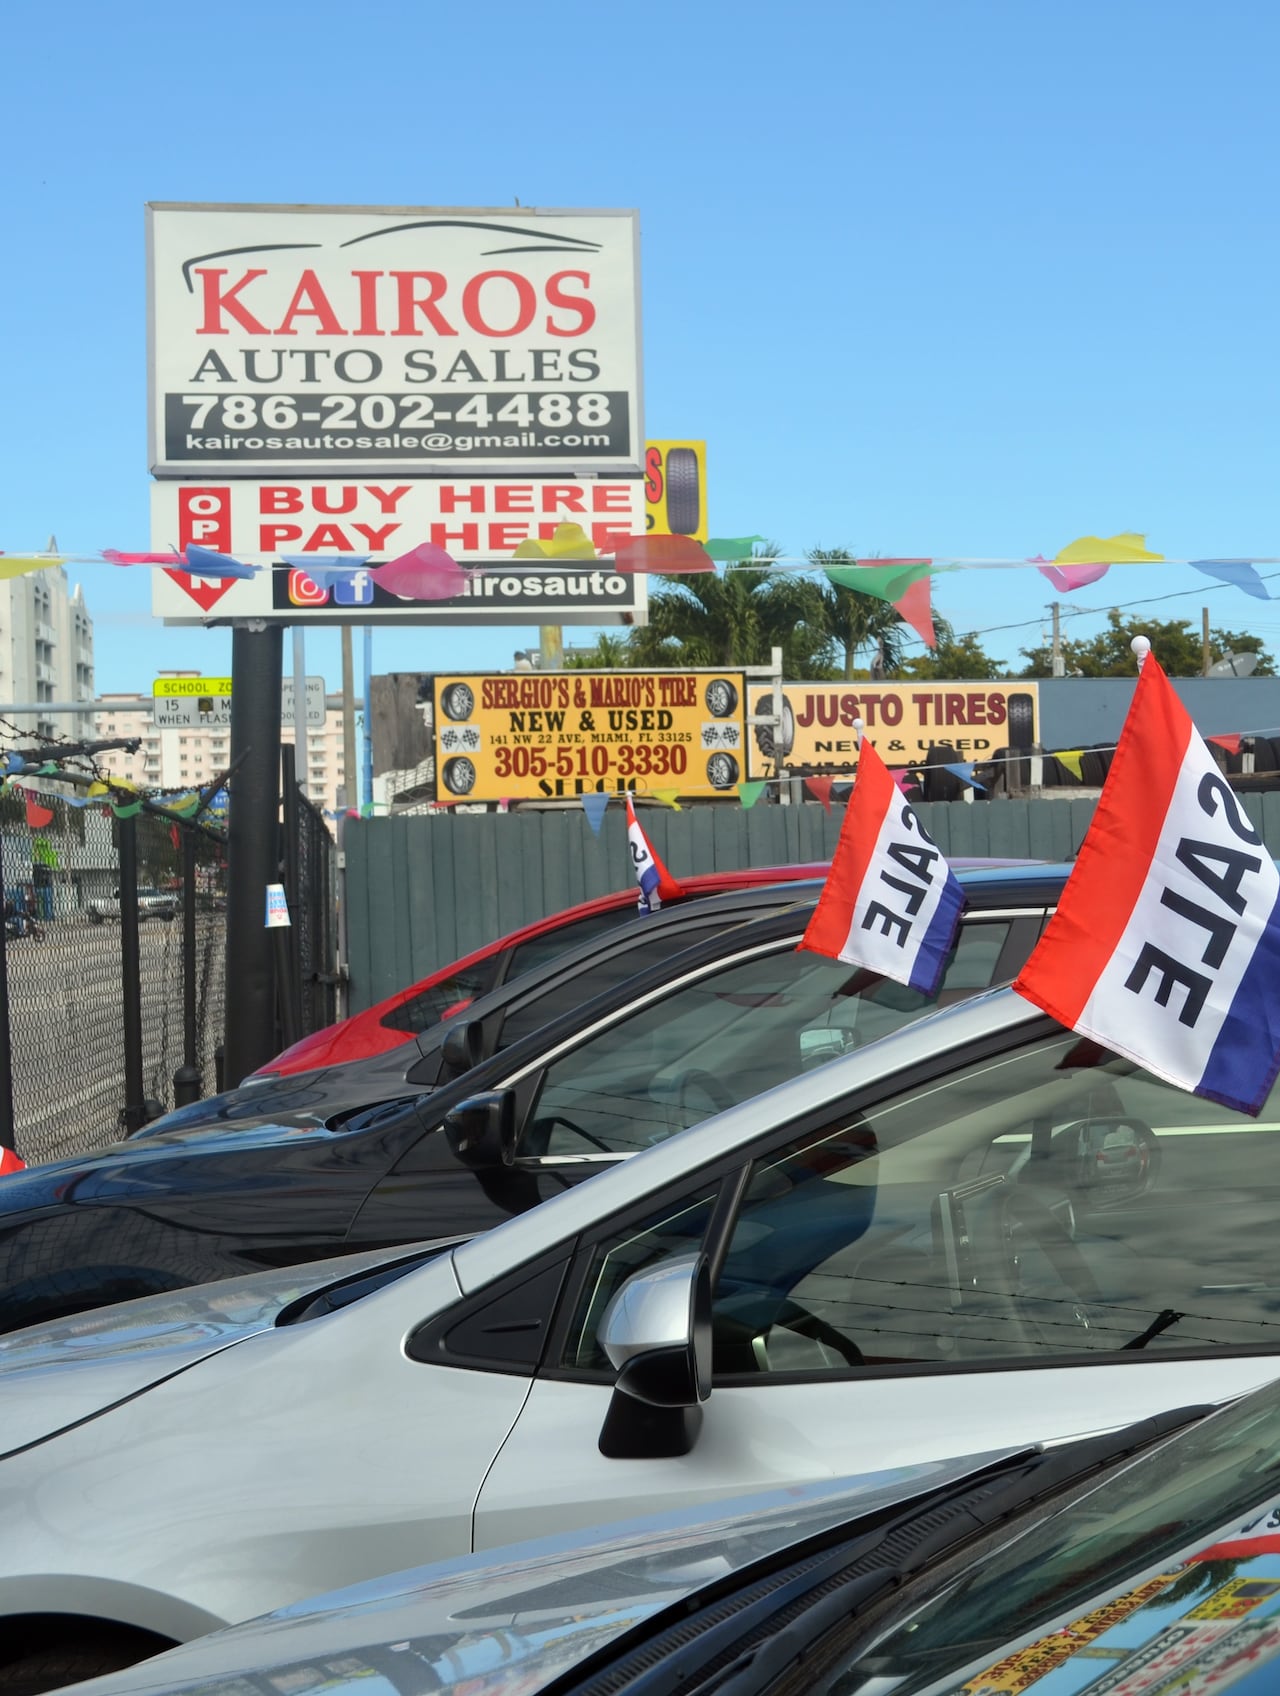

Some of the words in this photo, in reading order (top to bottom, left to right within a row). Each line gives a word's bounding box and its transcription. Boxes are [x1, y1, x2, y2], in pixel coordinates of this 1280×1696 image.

[194, 268, 597, 338] KAIROS
[188, 348, 384, 384] AUTO
[403, 348, 602, 383] SALES
[182, 393, 612, 431] 786-202-4488
[185, 432, 611, 452] kairosautosale@gmail.com
[259, 486, 414, 514] BUY
[439, 485, 633, 513] HERE
[188, 494, 222, 589] OPN
[259, 523, 402, 552] PAY
[163, 682, 209, 693] SCHOOL
[218, 681, 232, 693] ZO
[481, 678, 569, 709] SERGIO'S
[574, 680, 587, 707] &
[590, 677, 655, 708] MARIO'S
[659, 676, 697, 707] TIRE
[158, 714, 190, 725] WHEN
[166, 699, 179, 712] 15
[796, 693, 904, 728] JUSTO
[911, 692, 1007, 727] TIRES
[509, 710, 566, 732] NEW
[578, 711, 595, 732] &
[609, 709, 674, 730] USED
[490, 735, 508, 745] 141
[513, 734, 532, 744] NW
[537, 734, 553, 744] 22
[638, 732, 654, 743] FL
[657, 732, 693, 743] 33125
[887, 739, 907, 752] &
[917, 738, 990, 751] USED
[494, 744, 687, 778] 305-510-3330
